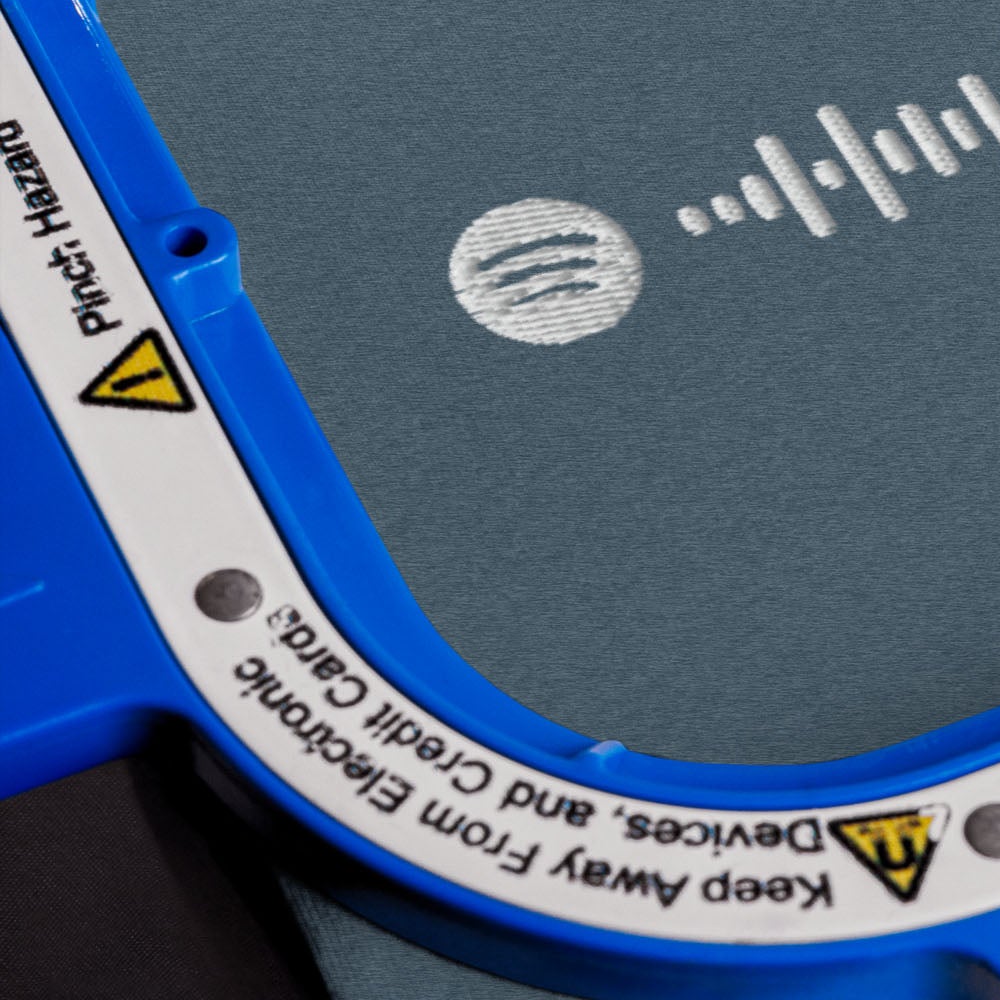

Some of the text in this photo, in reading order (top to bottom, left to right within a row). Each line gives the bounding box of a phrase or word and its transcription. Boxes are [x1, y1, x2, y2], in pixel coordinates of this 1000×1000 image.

[47, 239, 123, 338] Pinch
[232, 656, 834, 911] Keep Away From Electronic
[362, 702, 494, 796] Credit
[498, 779, 597, 829] and
[613, 806, 828, 855] Devices,
